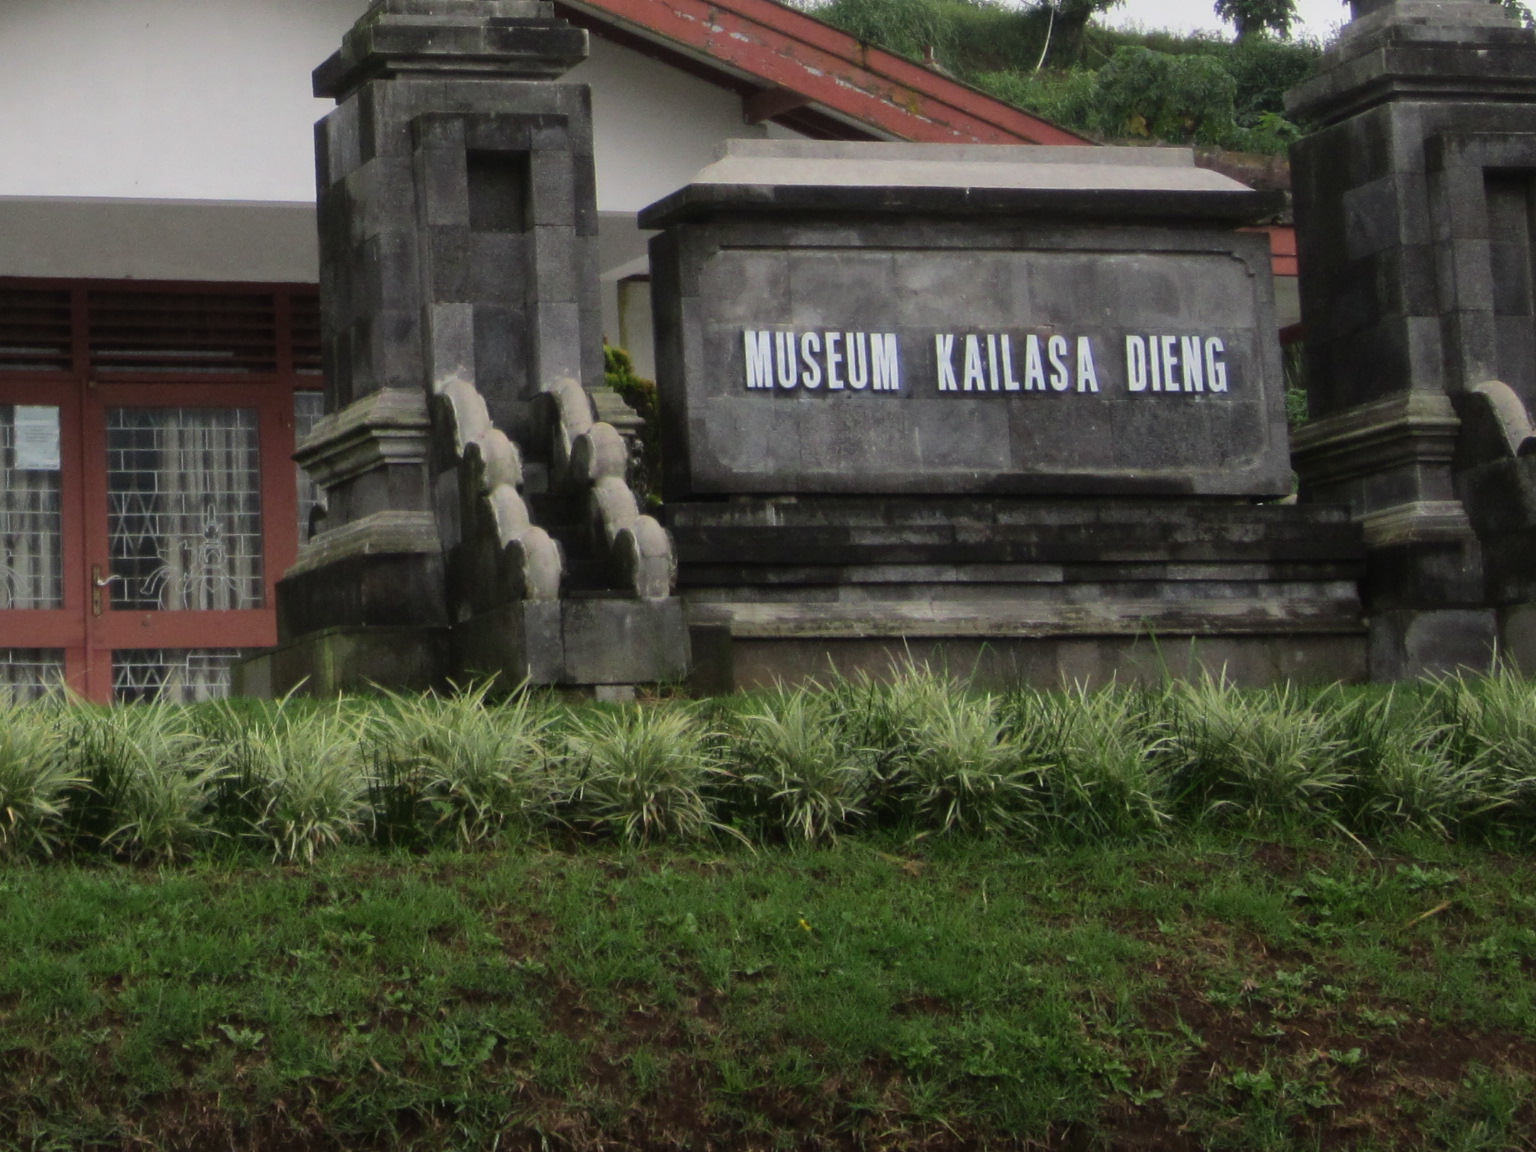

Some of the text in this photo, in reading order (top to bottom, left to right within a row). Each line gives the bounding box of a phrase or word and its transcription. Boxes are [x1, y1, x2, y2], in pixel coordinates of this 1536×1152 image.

[744, 330, 1228, 393] MUSEUM KAILASA DIENG
